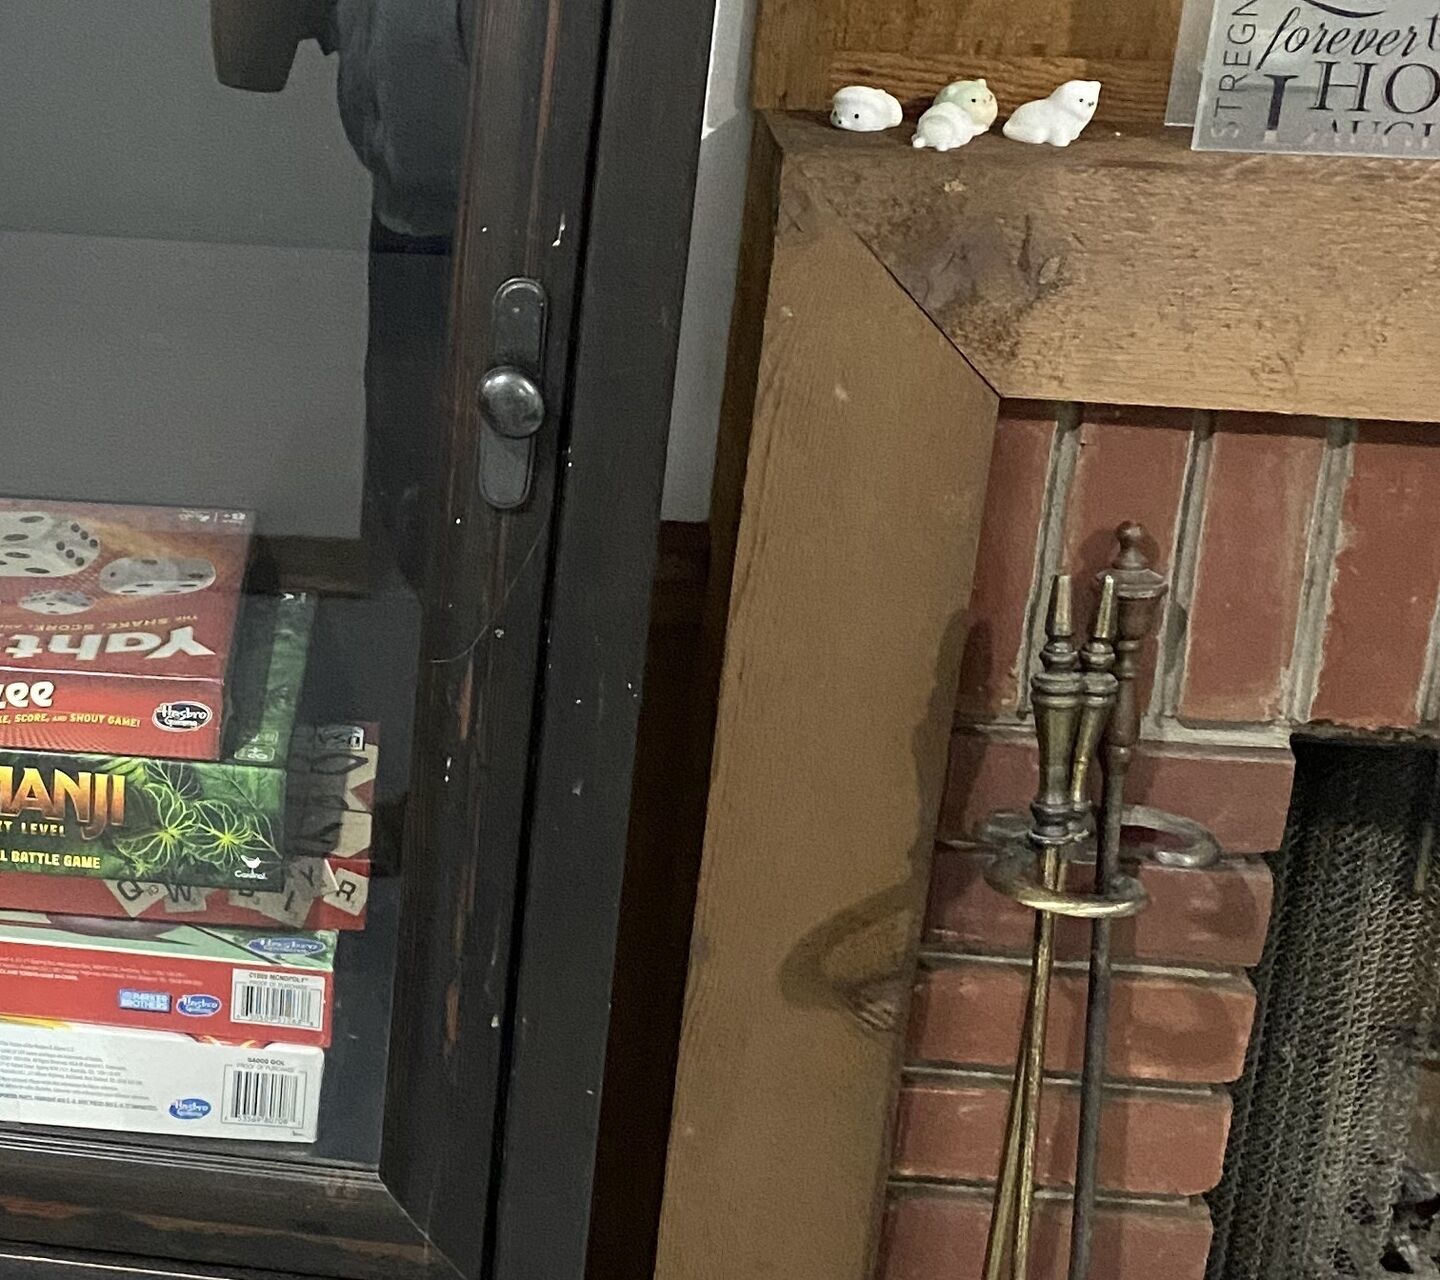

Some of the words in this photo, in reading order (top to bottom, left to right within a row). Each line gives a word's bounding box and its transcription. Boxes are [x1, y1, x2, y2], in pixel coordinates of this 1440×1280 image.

[1256, 7, 1420, 72] forever
[15, 713, 50, 723] SCORE,
[69, 713, 105, 724] SHOUT
[107, 716, 141, 728] GAME!
[157, 703, 207, 720] Hasbro
[21, 822, 66, 837] LEVEL
[11, 850, 61, 866] BATTLE
[64, 854, 101, 869] GAME
[337, 880, 357, 902] R
